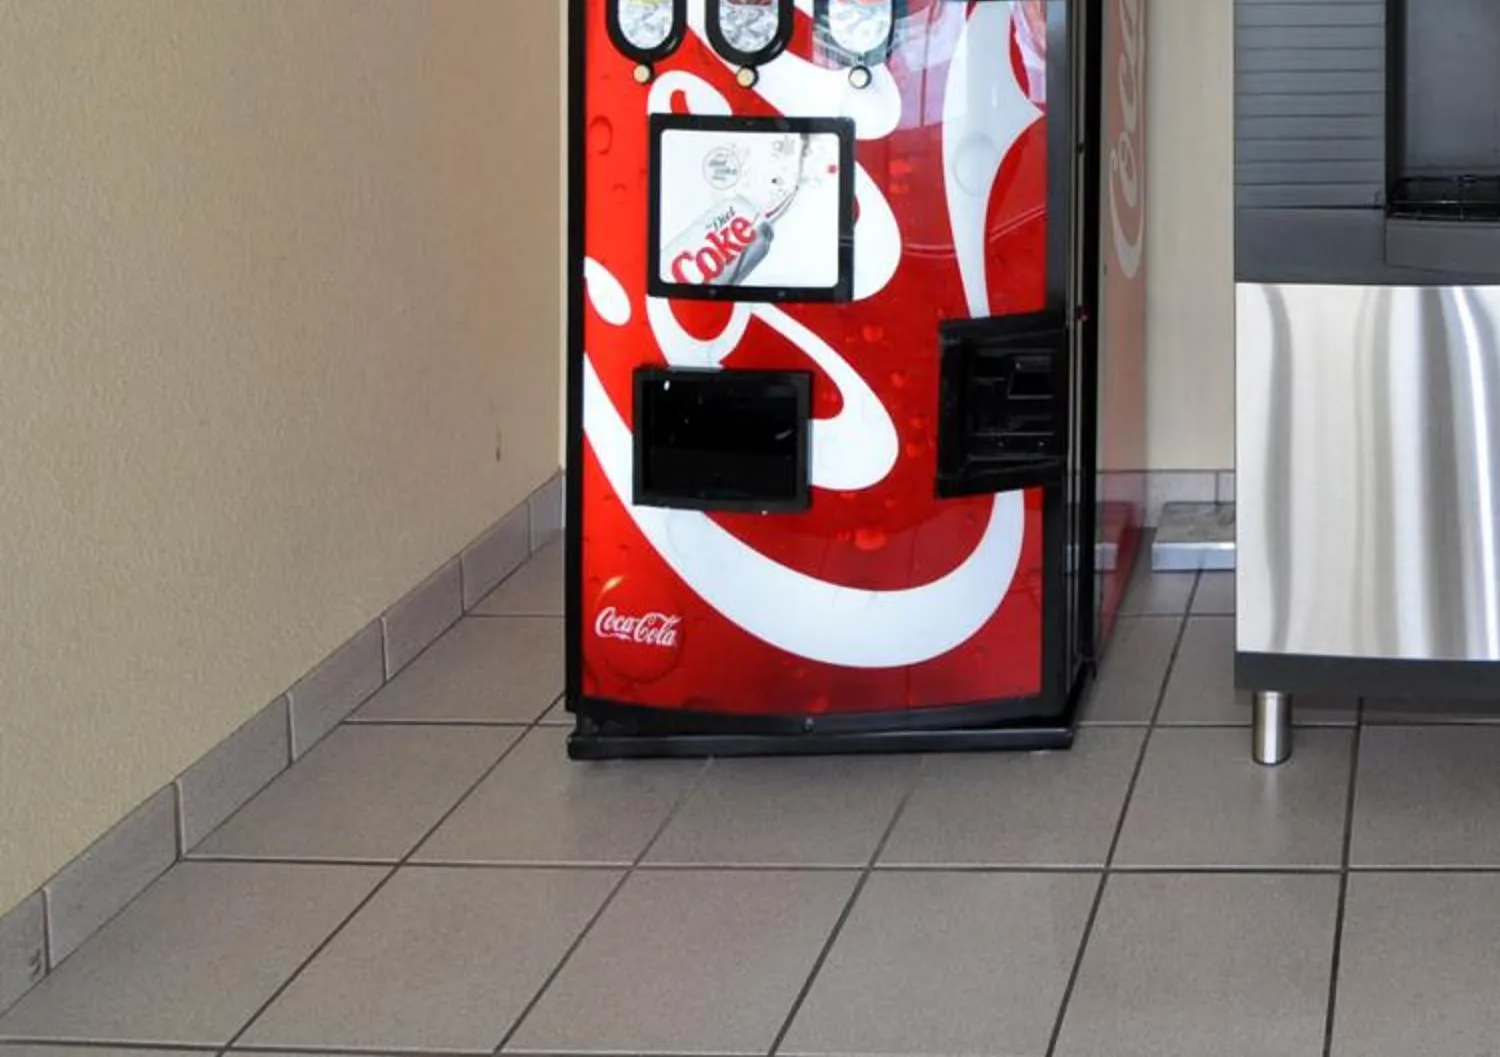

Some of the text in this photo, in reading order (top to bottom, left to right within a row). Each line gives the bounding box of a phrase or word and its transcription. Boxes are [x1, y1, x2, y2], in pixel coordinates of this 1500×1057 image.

[671, 206, 757, 284] Diet Coke
[595, 606, 681, 647] Coca-Cola
